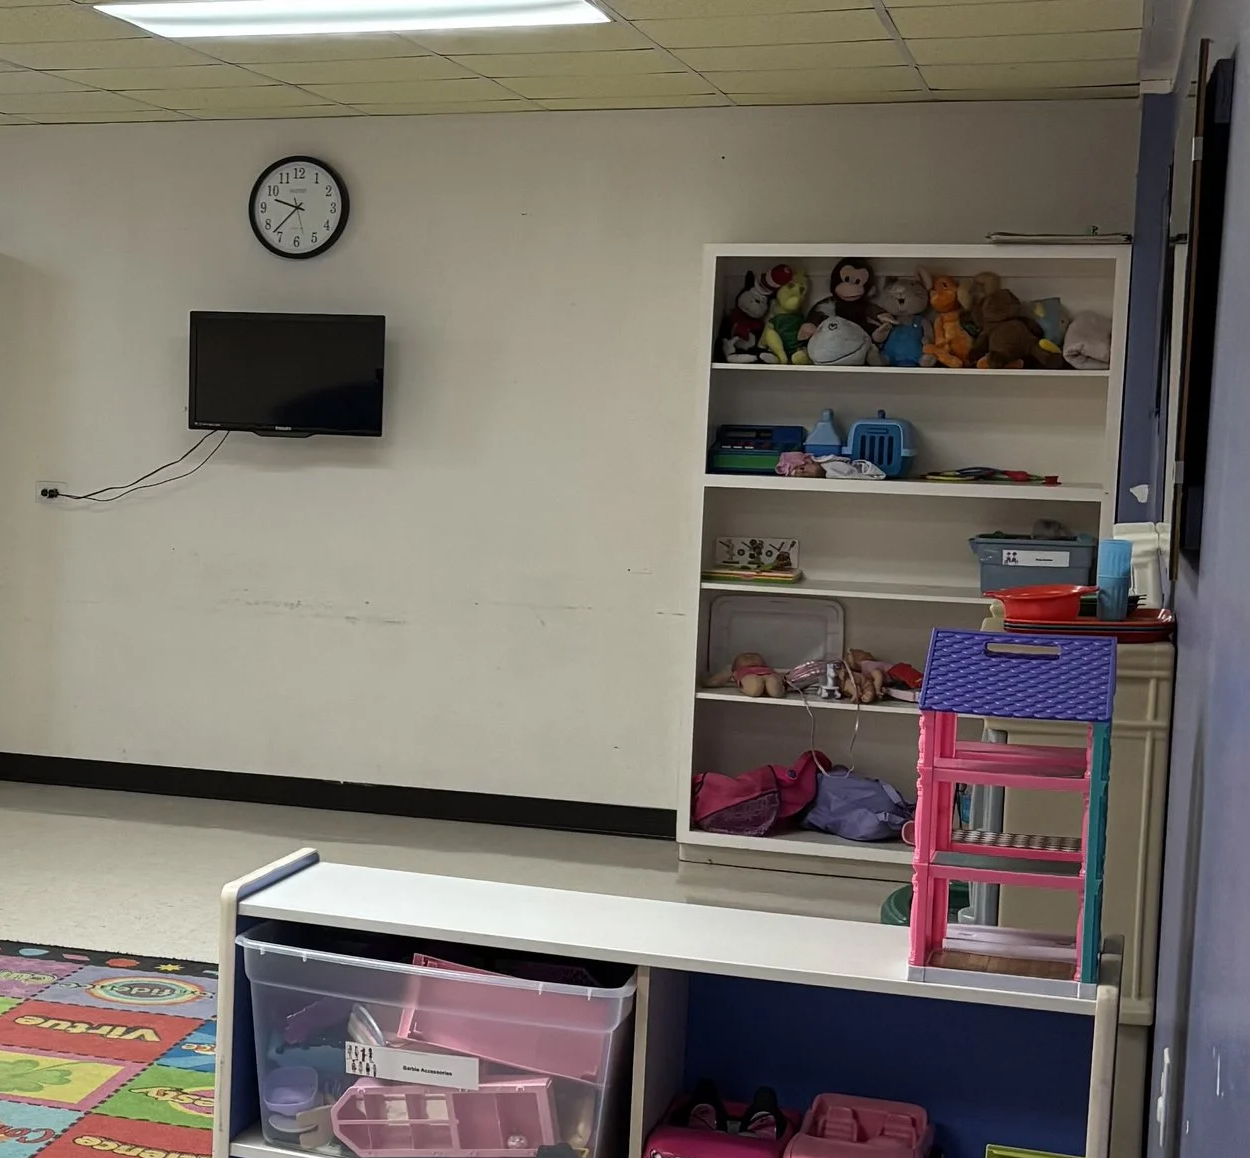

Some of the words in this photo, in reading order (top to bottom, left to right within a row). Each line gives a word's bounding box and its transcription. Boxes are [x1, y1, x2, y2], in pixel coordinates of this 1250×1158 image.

[279, 172, 290, 185] 11
[293, 167, 306, 179] 12
[267, 185, 280, 197] 10
[325, 184, 333, 197] 2
[260, 201, 267, 214] 9
[330, 202, 337, 214] 3
[264, 218, 272, 231] 8
[323, 219, 330, 231] 4
[277, 231, 283, 243] 7
[293, 235, 300, 248] 6
[311, 232, 318, 243] 5
[14, 1015, 161, 1042] Virtue
[403, 1065, 420, 1073] Barbie
[421, 1067, 453, 1076] Accessories
